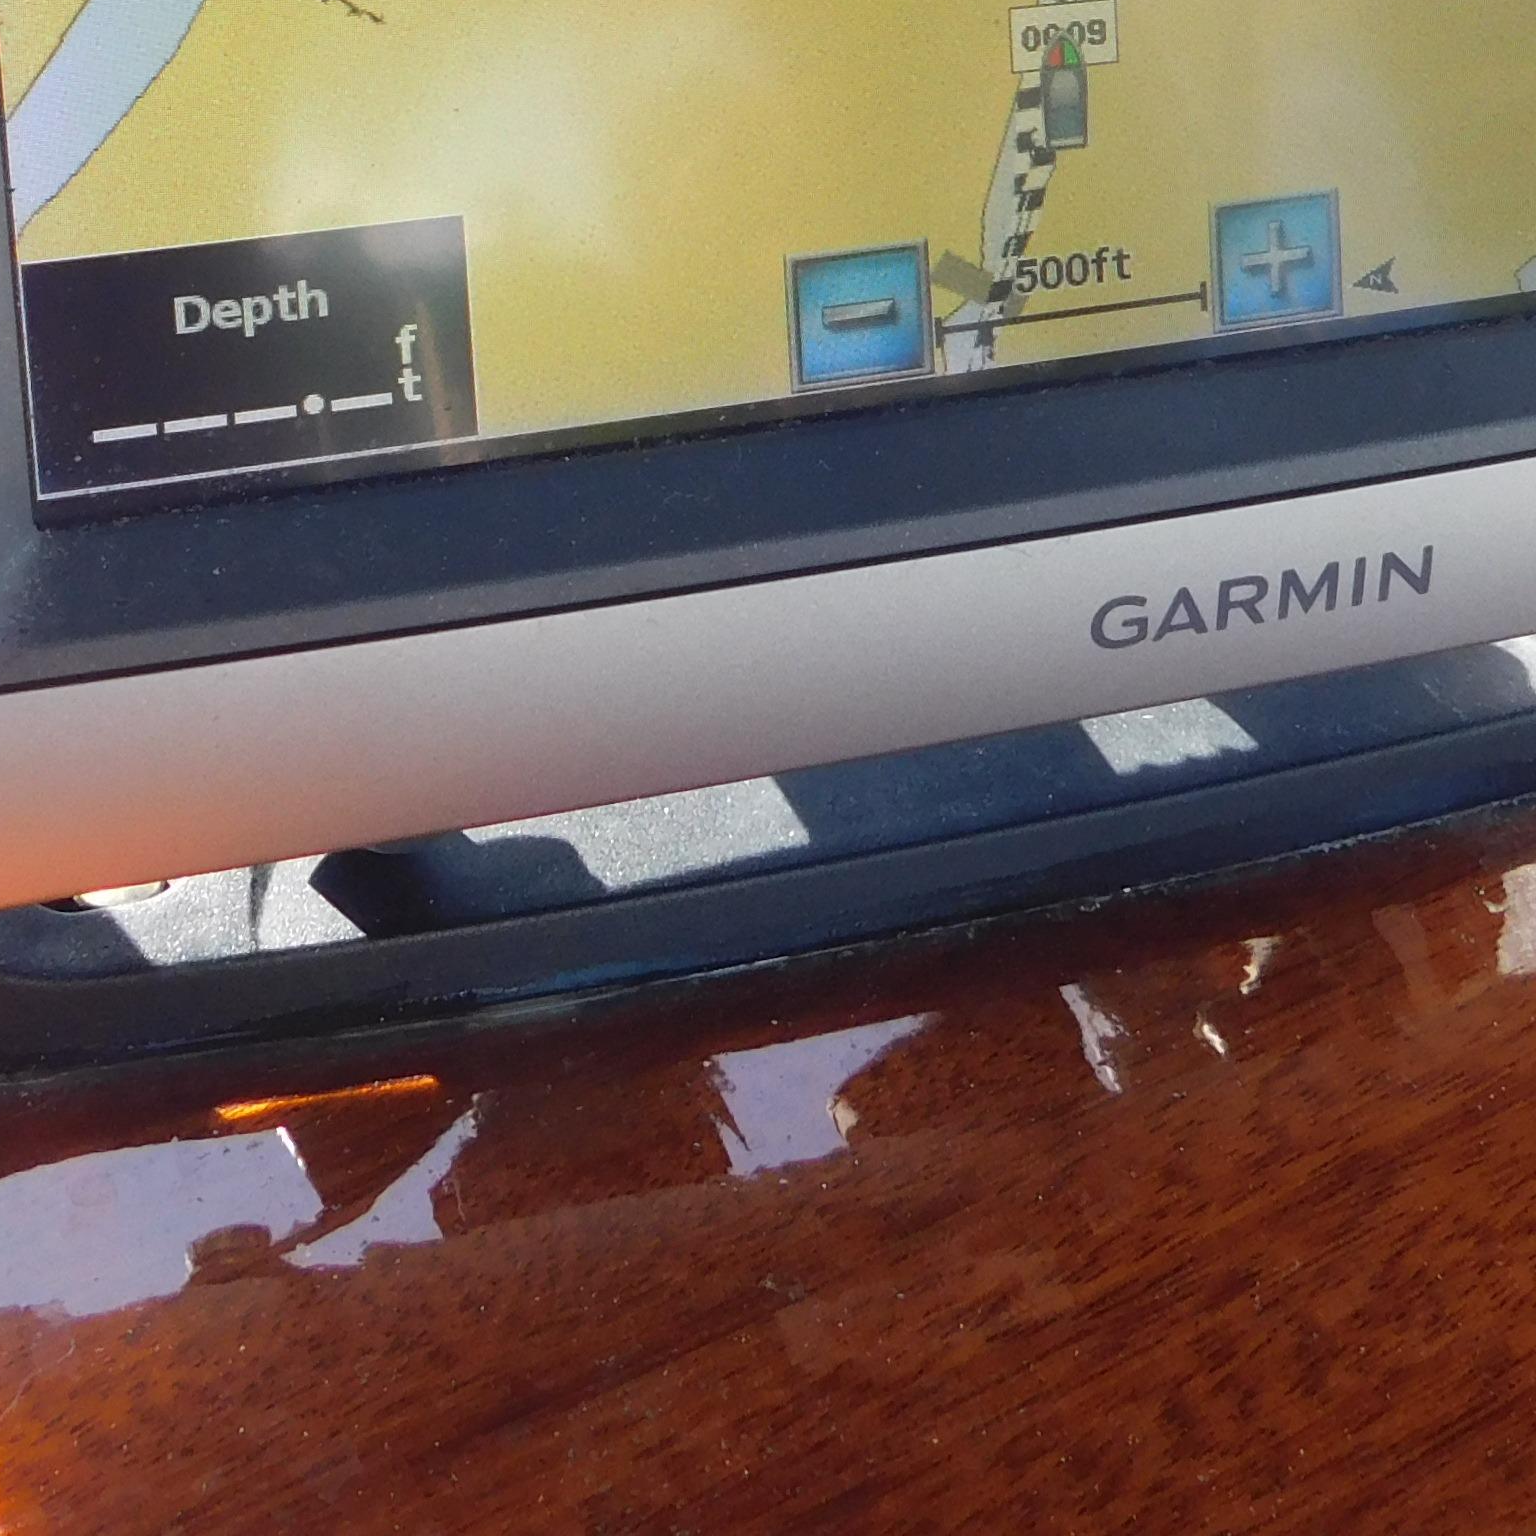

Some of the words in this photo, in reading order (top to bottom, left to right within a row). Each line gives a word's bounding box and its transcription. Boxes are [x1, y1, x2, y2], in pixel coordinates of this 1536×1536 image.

[1014, 246, 1132, 294] 500ft
[173, 279, 329, 338] Depth
[1090, 545, 1434, 650] GARMIN
